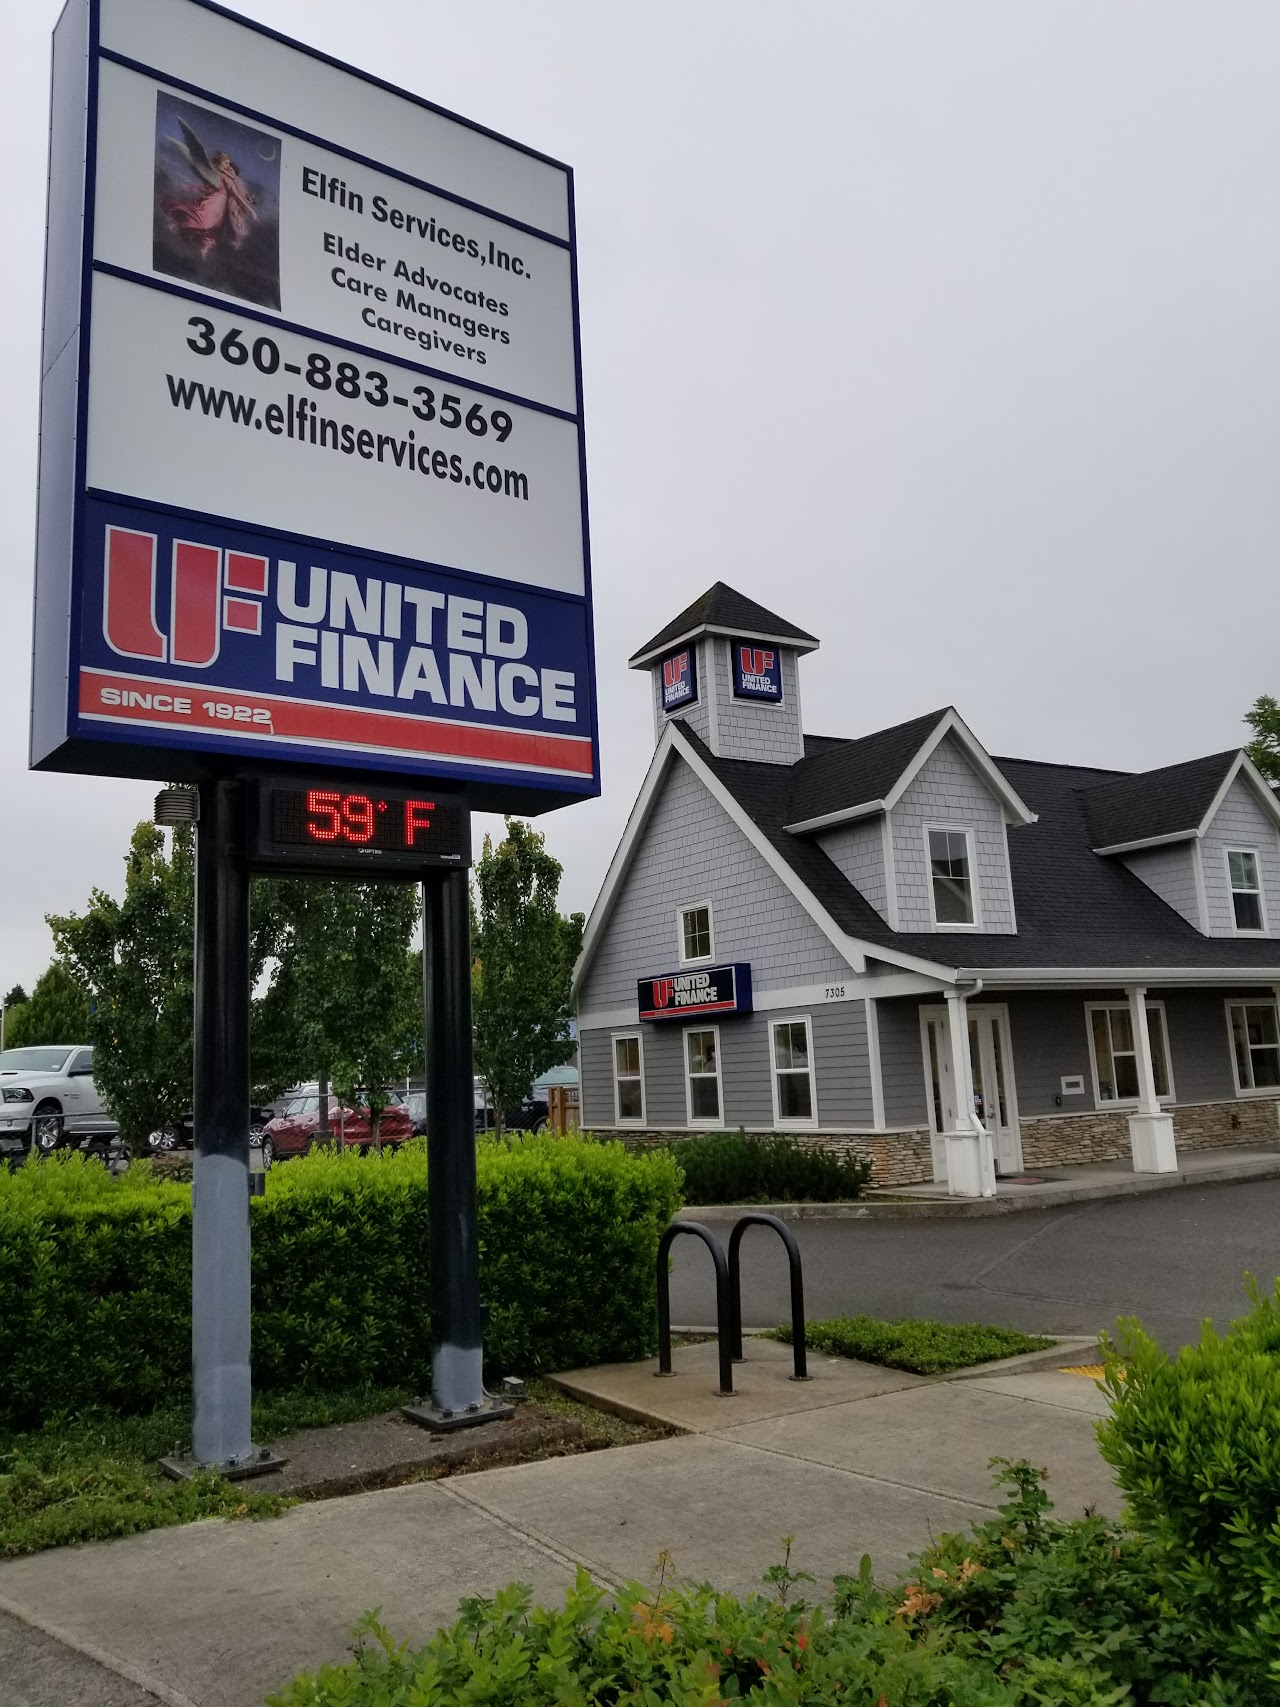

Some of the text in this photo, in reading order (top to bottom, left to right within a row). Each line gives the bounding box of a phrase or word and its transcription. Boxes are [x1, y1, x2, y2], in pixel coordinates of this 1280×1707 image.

[302, 165, 364, 214] Elfin
[323, 231, 510, 317] Elder Advocates
[331, 266, 511, 345] Care Managers
[361, 307, 487, 365] Caregivers
[186, 316, 513, 443] 360-883-3569
[166, 373, 530, 501] www.elfinservices.com
[276, 559, 529, 660] UNITED
[275, 622, 577, 723] FINANCE
[665, 680, 686, 696] UNITED
[665, 685, 690, 704] FINANCE
[741, 673, 771, 685] UNITED
[742, 681, 778, 693] FINANCE
[99, 687, 272, 724] SINCE 1922
[405, 800, 436, 845] F
[674, 973, 710, 991] UNITED
[674, 986, 718, 1006] FINANCE
[825, 987, 845, 999] 7305
